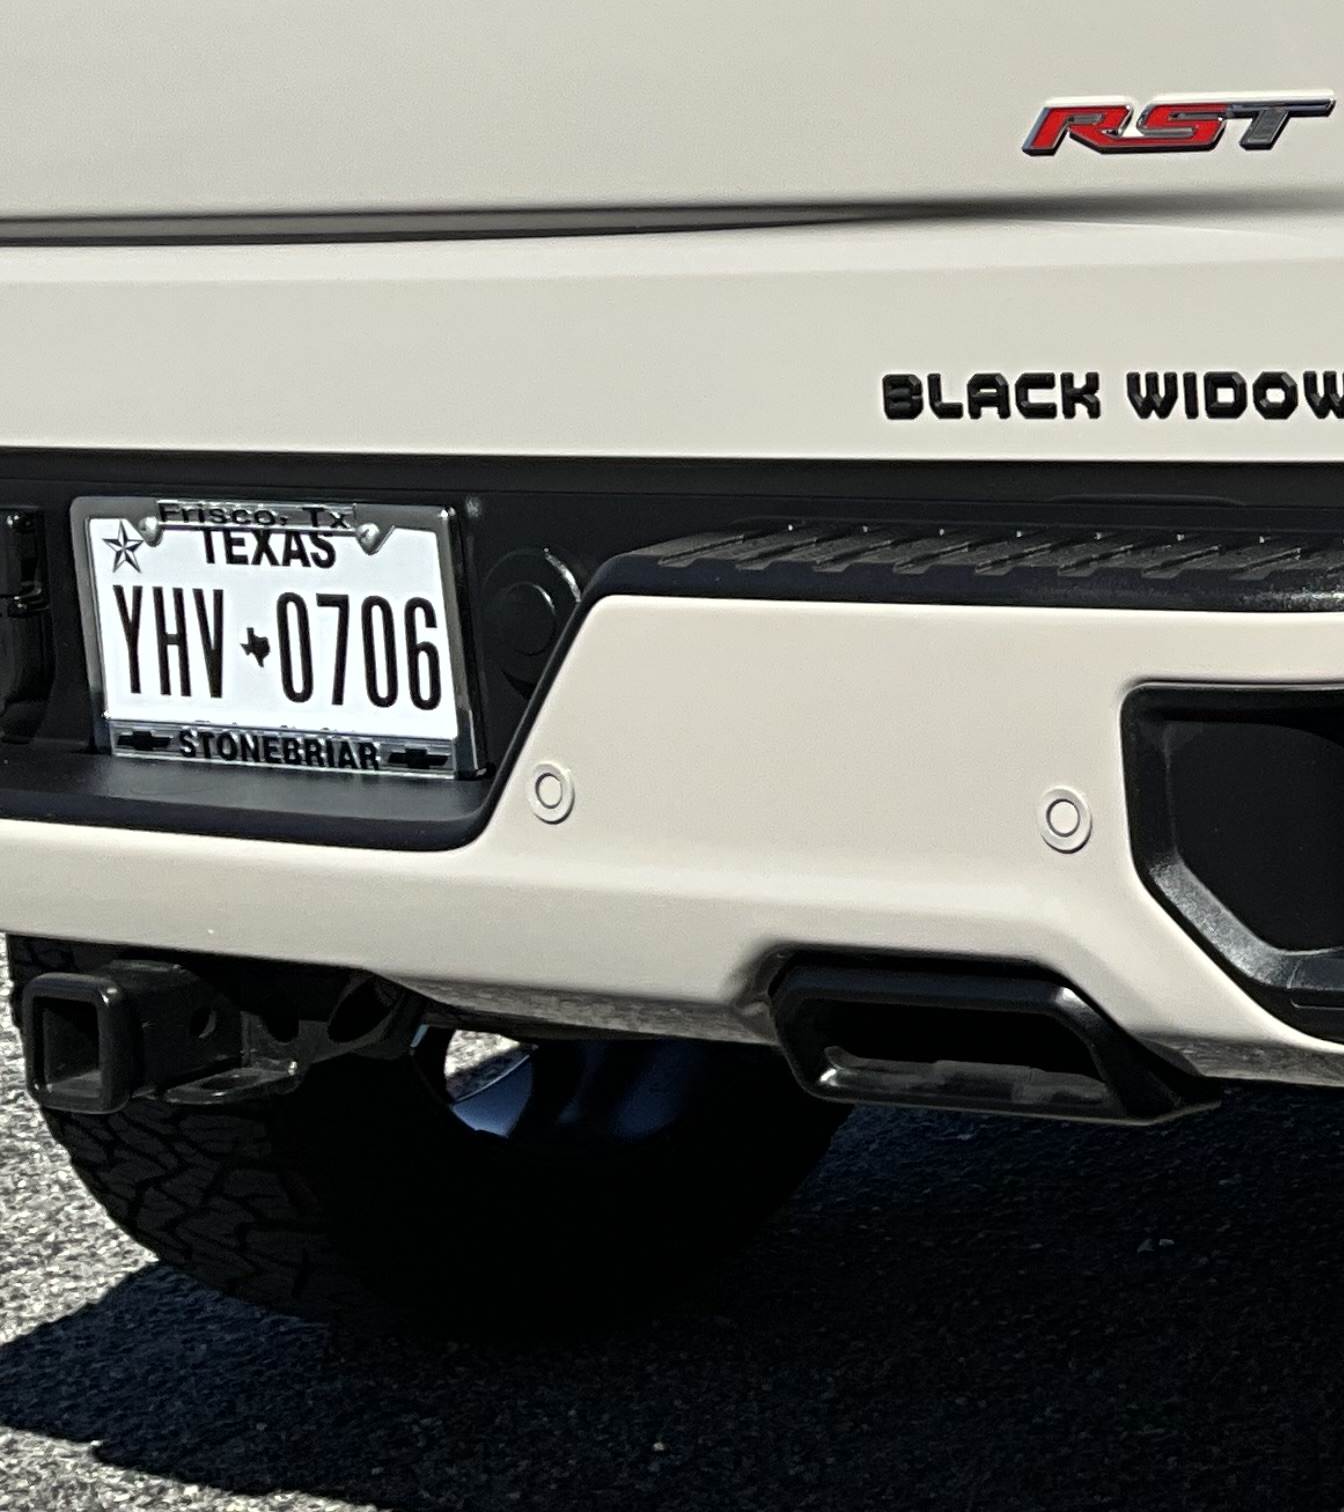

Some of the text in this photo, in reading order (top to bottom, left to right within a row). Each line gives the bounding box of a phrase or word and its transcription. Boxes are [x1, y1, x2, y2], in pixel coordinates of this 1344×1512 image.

[1022, 89, 1337, 156] RST
[881, 372, 1101, 420] BLACK
[202, 528, 337, 569] TEXAS
[112, 585, 442, 711] YHV 0706
[178, 729, 380, 771] STONEBRIAR
